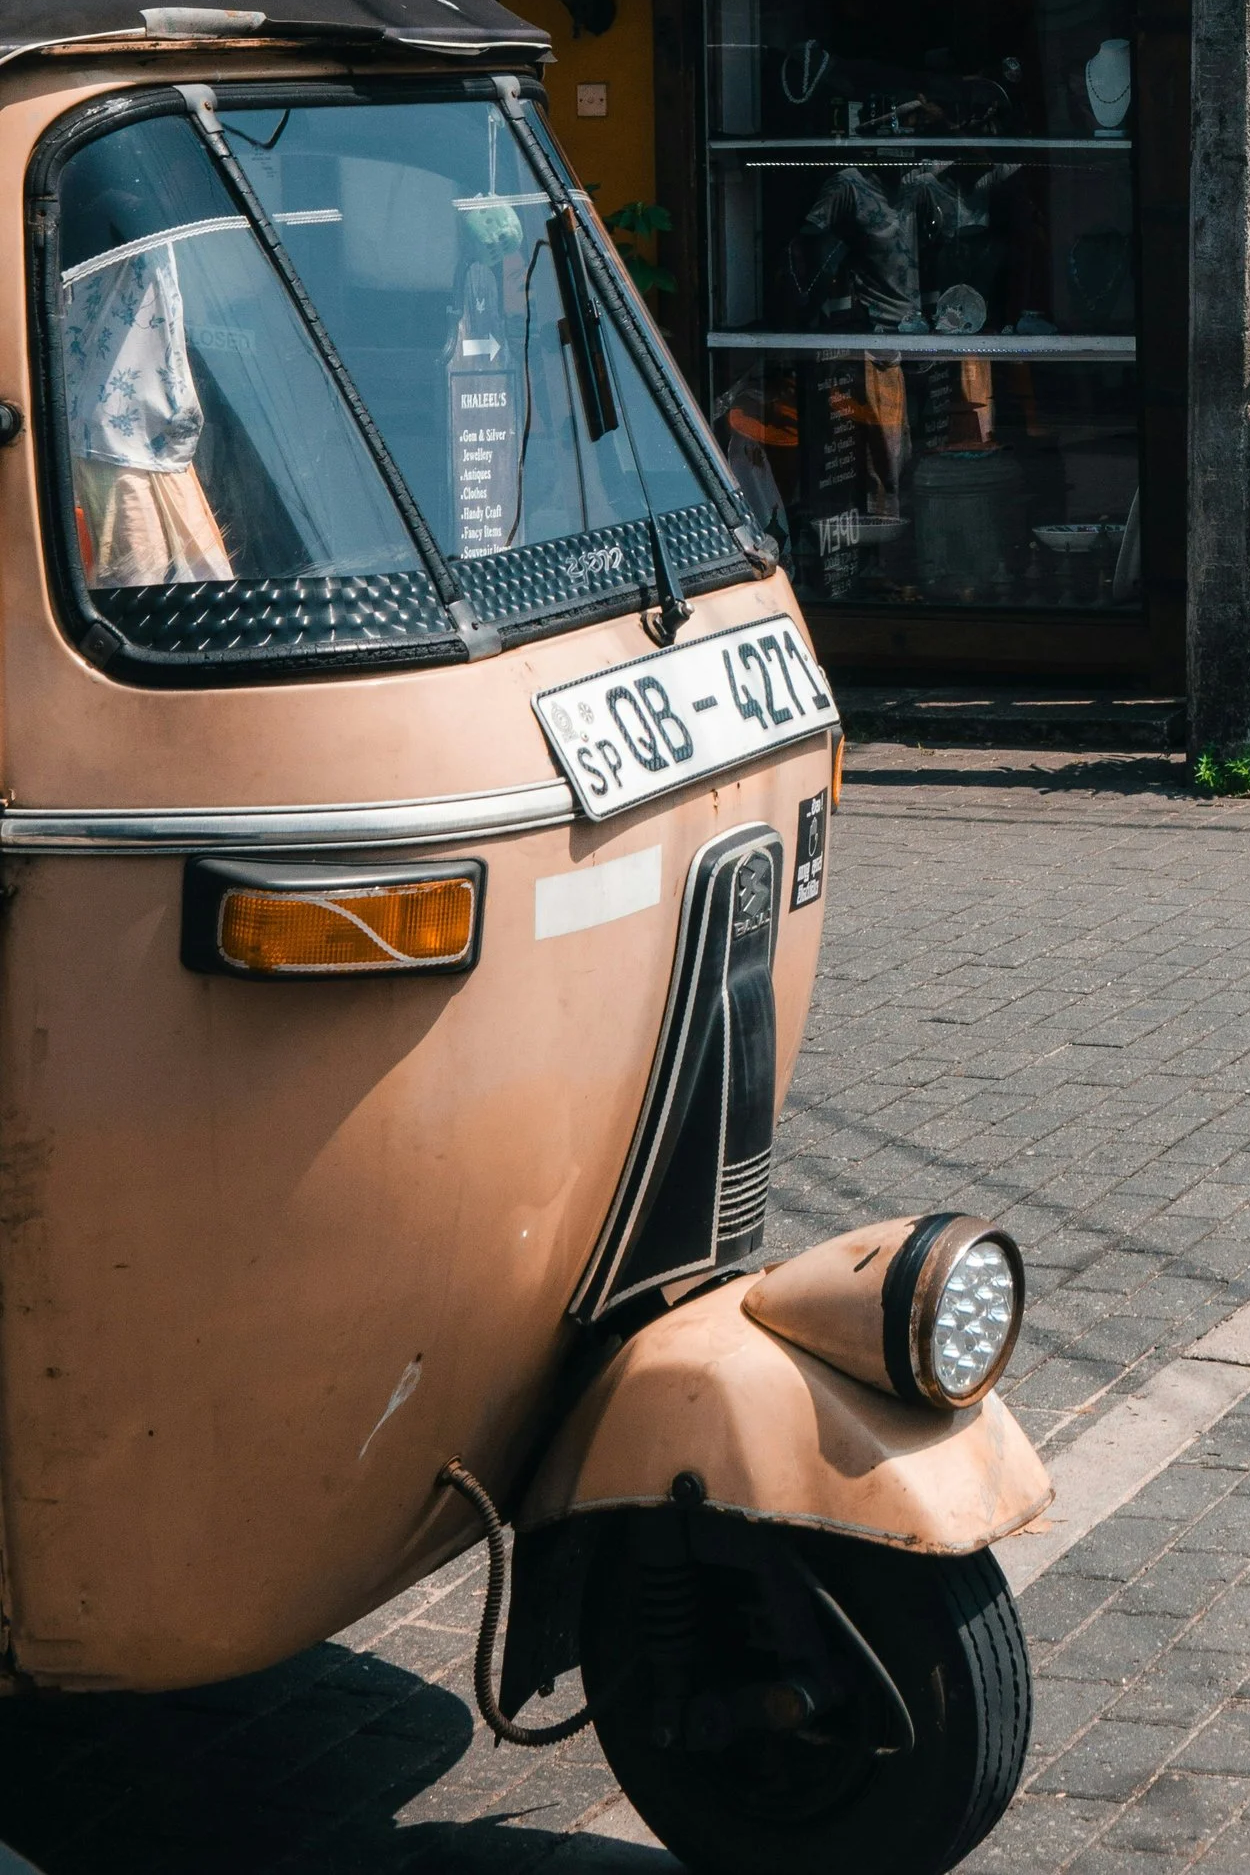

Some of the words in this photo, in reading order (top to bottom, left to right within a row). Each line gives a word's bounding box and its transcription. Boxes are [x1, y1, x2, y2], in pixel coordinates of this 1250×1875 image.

[461, 392, 507, 409] KHALEEL'S
[463, 429, 478, 443] Gem
[479, 428, 484, 442] &
[486, 427, 507, 442] Silver
[463, 449, 493, 463] Jewellery
[463, 468, 491, 484] Antiques
[463, 486, 487, 500] Clothes
[463, 506, 484, 522] Handy
[485, 504, 502, 519] Craft
[463, 525, 483, 541] Fancy
[484, 524, 502, 538] Items
[576, 737, 622, 797] SP
